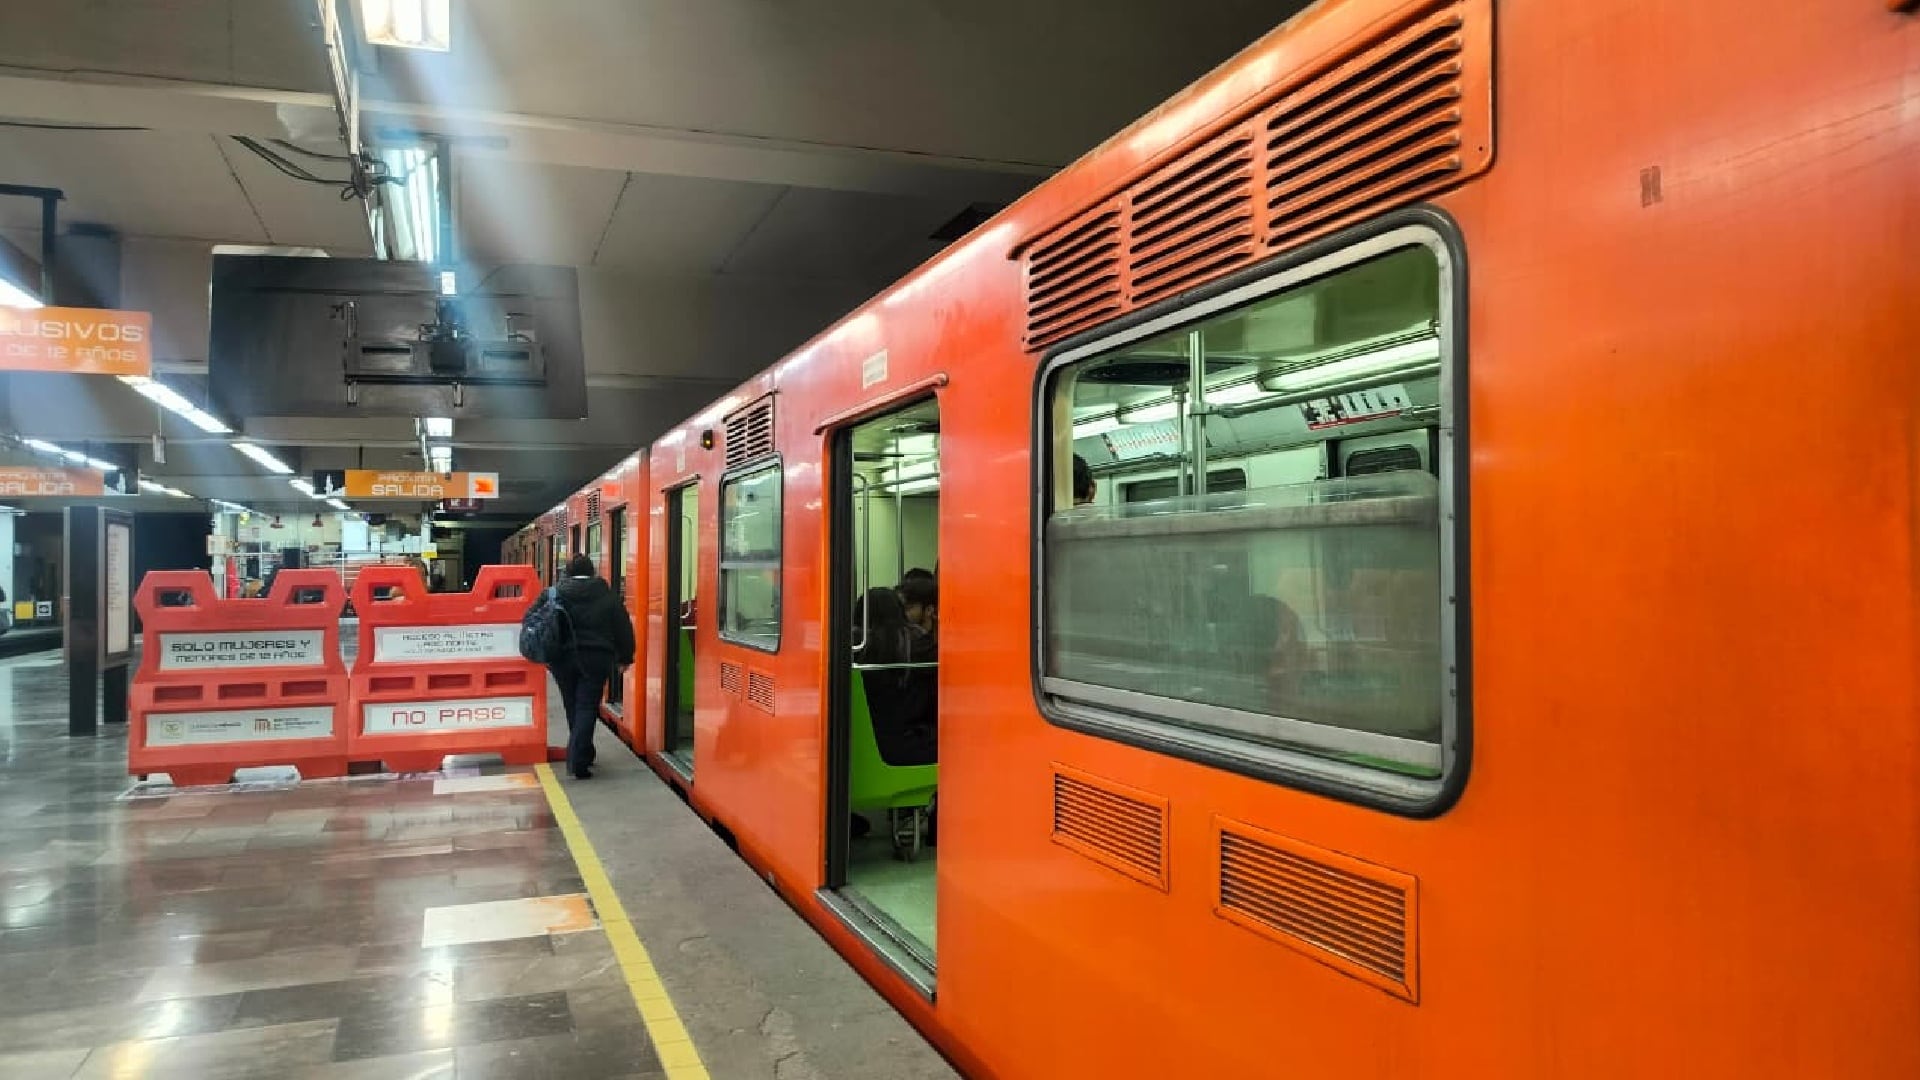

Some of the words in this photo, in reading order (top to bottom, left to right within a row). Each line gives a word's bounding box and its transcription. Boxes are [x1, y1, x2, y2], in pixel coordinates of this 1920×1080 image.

[371, 485, 443, 496] SALIDA
[171, 641, 216, 652] SOLO
[219, 639, 296, 651] MUJERES
[300, 639, 312, 648] Y
[392, 710, 426, 725] NO
[439, 707, 506, 723] PASE
